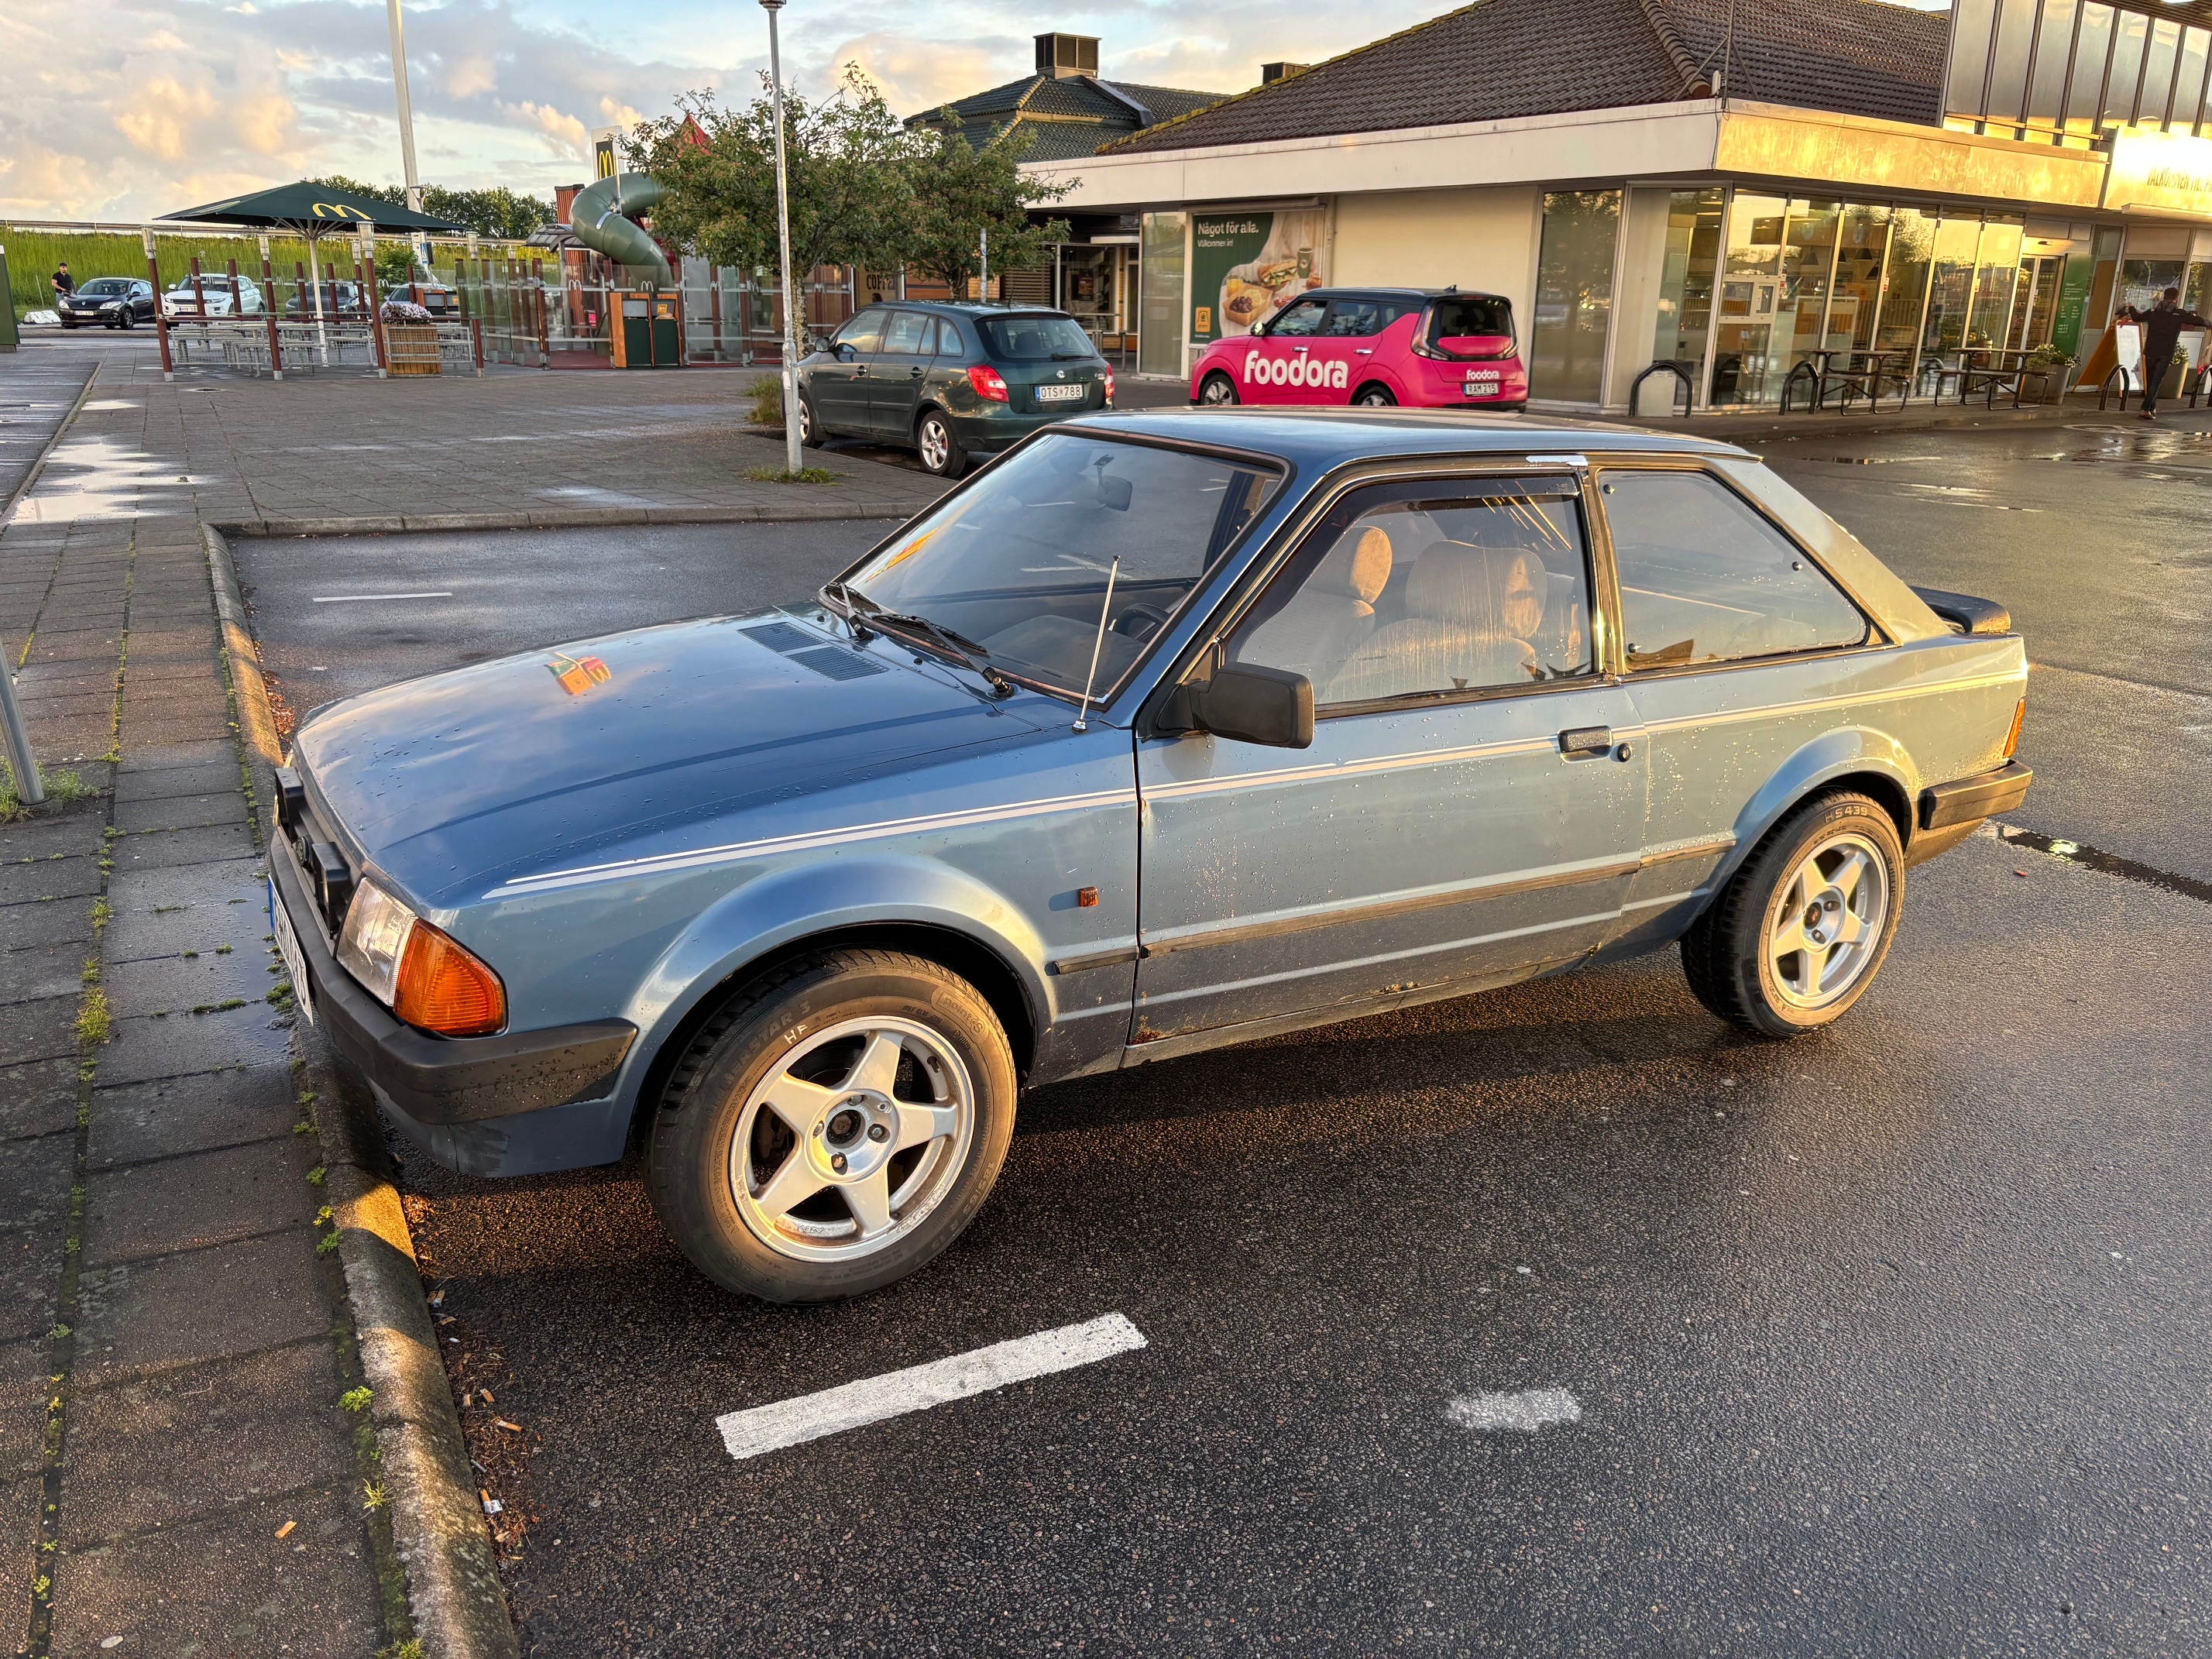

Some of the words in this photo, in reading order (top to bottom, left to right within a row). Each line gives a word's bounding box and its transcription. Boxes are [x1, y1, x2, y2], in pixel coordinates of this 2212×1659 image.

[1197, 222, 1225, 238] Något
[1225, 222, 1240, 234] för
[1240, 221, 1259, 234] alla.
[1244, 350, 1348, 389] foodora
[1466, 369, 1499, 380] foodora
[1041, 387, 1058, 397] OTS
[1063, 386, 1081, 397] 788
[1482, 384, 1496, 393] 215
[799, 1000, 812, 1015] 3
